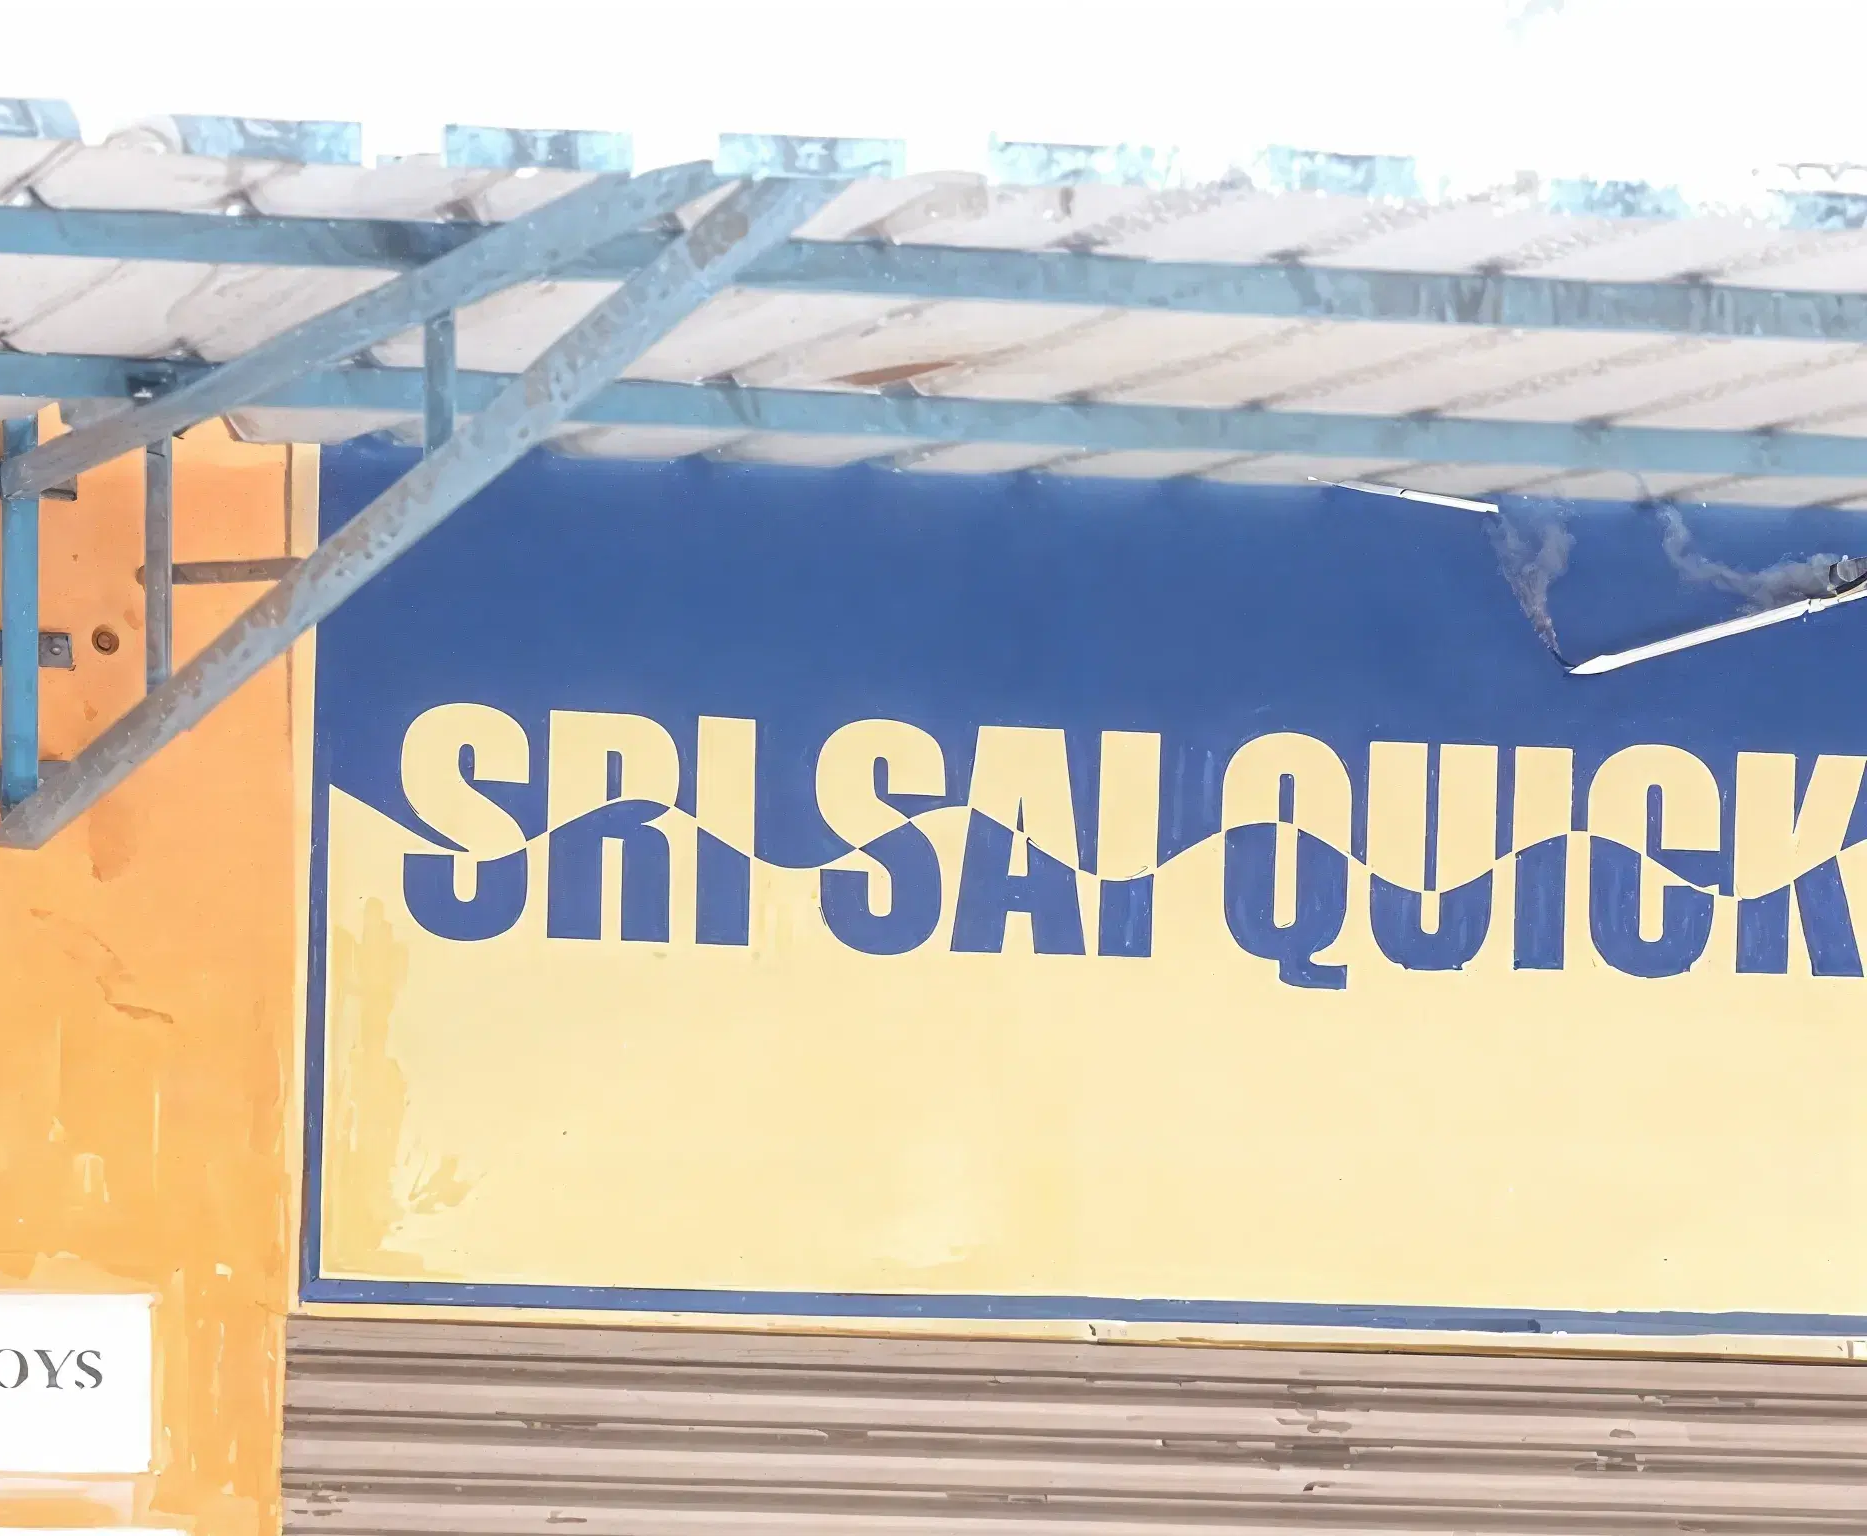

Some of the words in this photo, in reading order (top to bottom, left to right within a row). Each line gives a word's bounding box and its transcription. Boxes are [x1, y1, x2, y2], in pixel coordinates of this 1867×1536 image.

[400, 702, 756, 947] SRI
[815, 718, 1161, 958] SAI
[1221, 731, 1867, 990] QUICK
